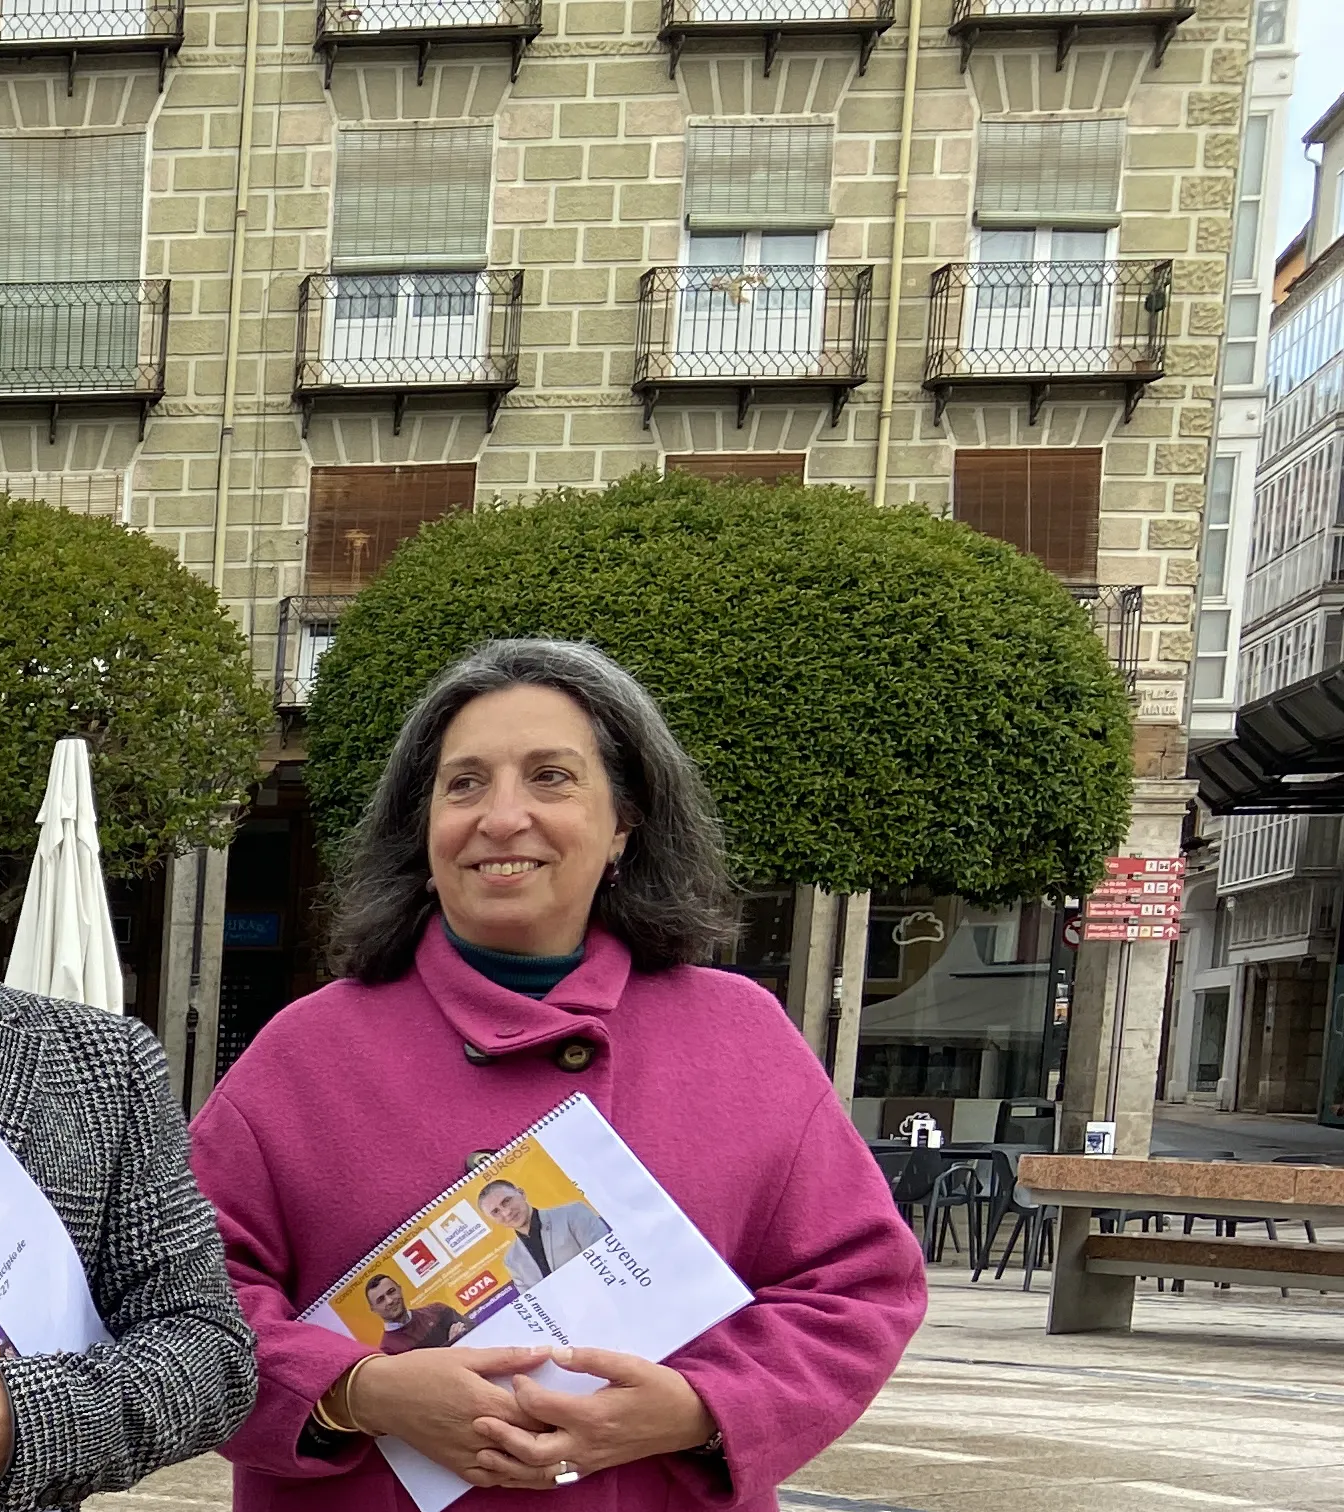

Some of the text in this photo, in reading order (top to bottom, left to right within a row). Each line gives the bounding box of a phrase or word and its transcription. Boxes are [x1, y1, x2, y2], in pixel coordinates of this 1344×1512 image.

[482, 1143, 531, 1182] BURGOS
[582, 1248, 627, 1287] ativa"
[604, 1232, 652, 1288] uyendo
[459, 1275, 495, 1302] VOTA
[530, 1302, 570, 1346] municipio
